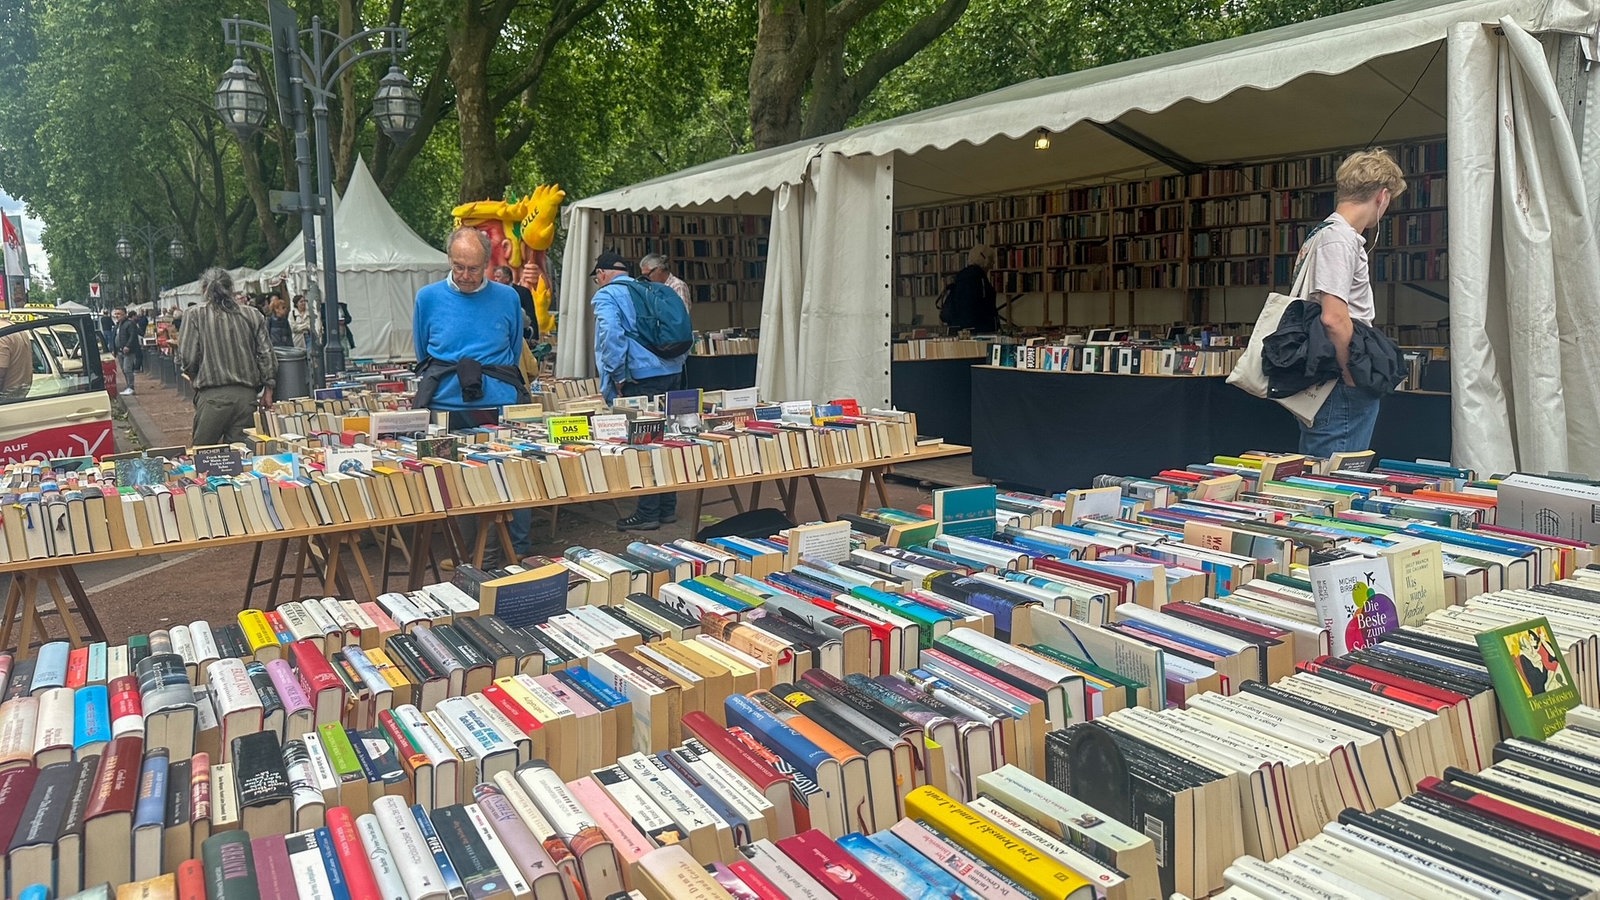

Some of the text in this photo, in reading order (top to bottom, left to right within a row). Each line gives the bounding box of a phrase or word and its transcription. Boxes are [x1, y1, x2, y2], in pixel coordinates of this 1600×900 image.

[562, 425, 578, 433] DAS
[634, 423, 661, 434] JUSTINE
[553, 435, 589, 444] INTERNET
[3, 443, 29, 453] AUF
[1338, 576, 1358, 586] MICHEL
[1405, 576, 1417, 589] Was
[1363, 600, 1380, 613] Die
[1357, 612, 1387, 629] Beste
[1366, 626, 1386, 638] zum
[1310, 701, 1338, 713] Wolfgang
[1528, 691, 1574, 712] Die schönsten
[612, 767, 630, 781] PIPER
[751, 762, 774, 777] ALESSANDRO
[244, 778, 262, 787] Zeiten
[652, 781, 672, 795] Baricco
[733, 780, 747, 789] Baricco
[253, 786, 276, 795] Gabriel
[723, 788, 738, 799] Baricco
[742, 789, 766, 804] Alessandro
[552, 785, 582, 813] JOHN BANVILLE
[692, 798, 706, 808] Baricco
[921, 789, 951, 807] Leute
[665, 795, 694, 817] Alessandro
[734, 798, 756, 814] Alessandro
[702, 808, 722, 823] Alessandro
[949, 807, 981, 826] Land
[976, 823, 1019, 849] Demski
[1339, 826, 1370, 841] Blutes
[304, 832, 319, 850] PIPER
[426, 838, 443, 850] PIPER
[1368, 839, 1388, 848] des
[933, 851, 945, 860] Der
[1014, 848, 1040, 863] Eva
[1386, 846, 1414, 858] Farbe
[1412, 856, 1432, 866] Die
[1436, 866, 1470, 881] Moore
[1469, 880, 1502, 895] Brian
